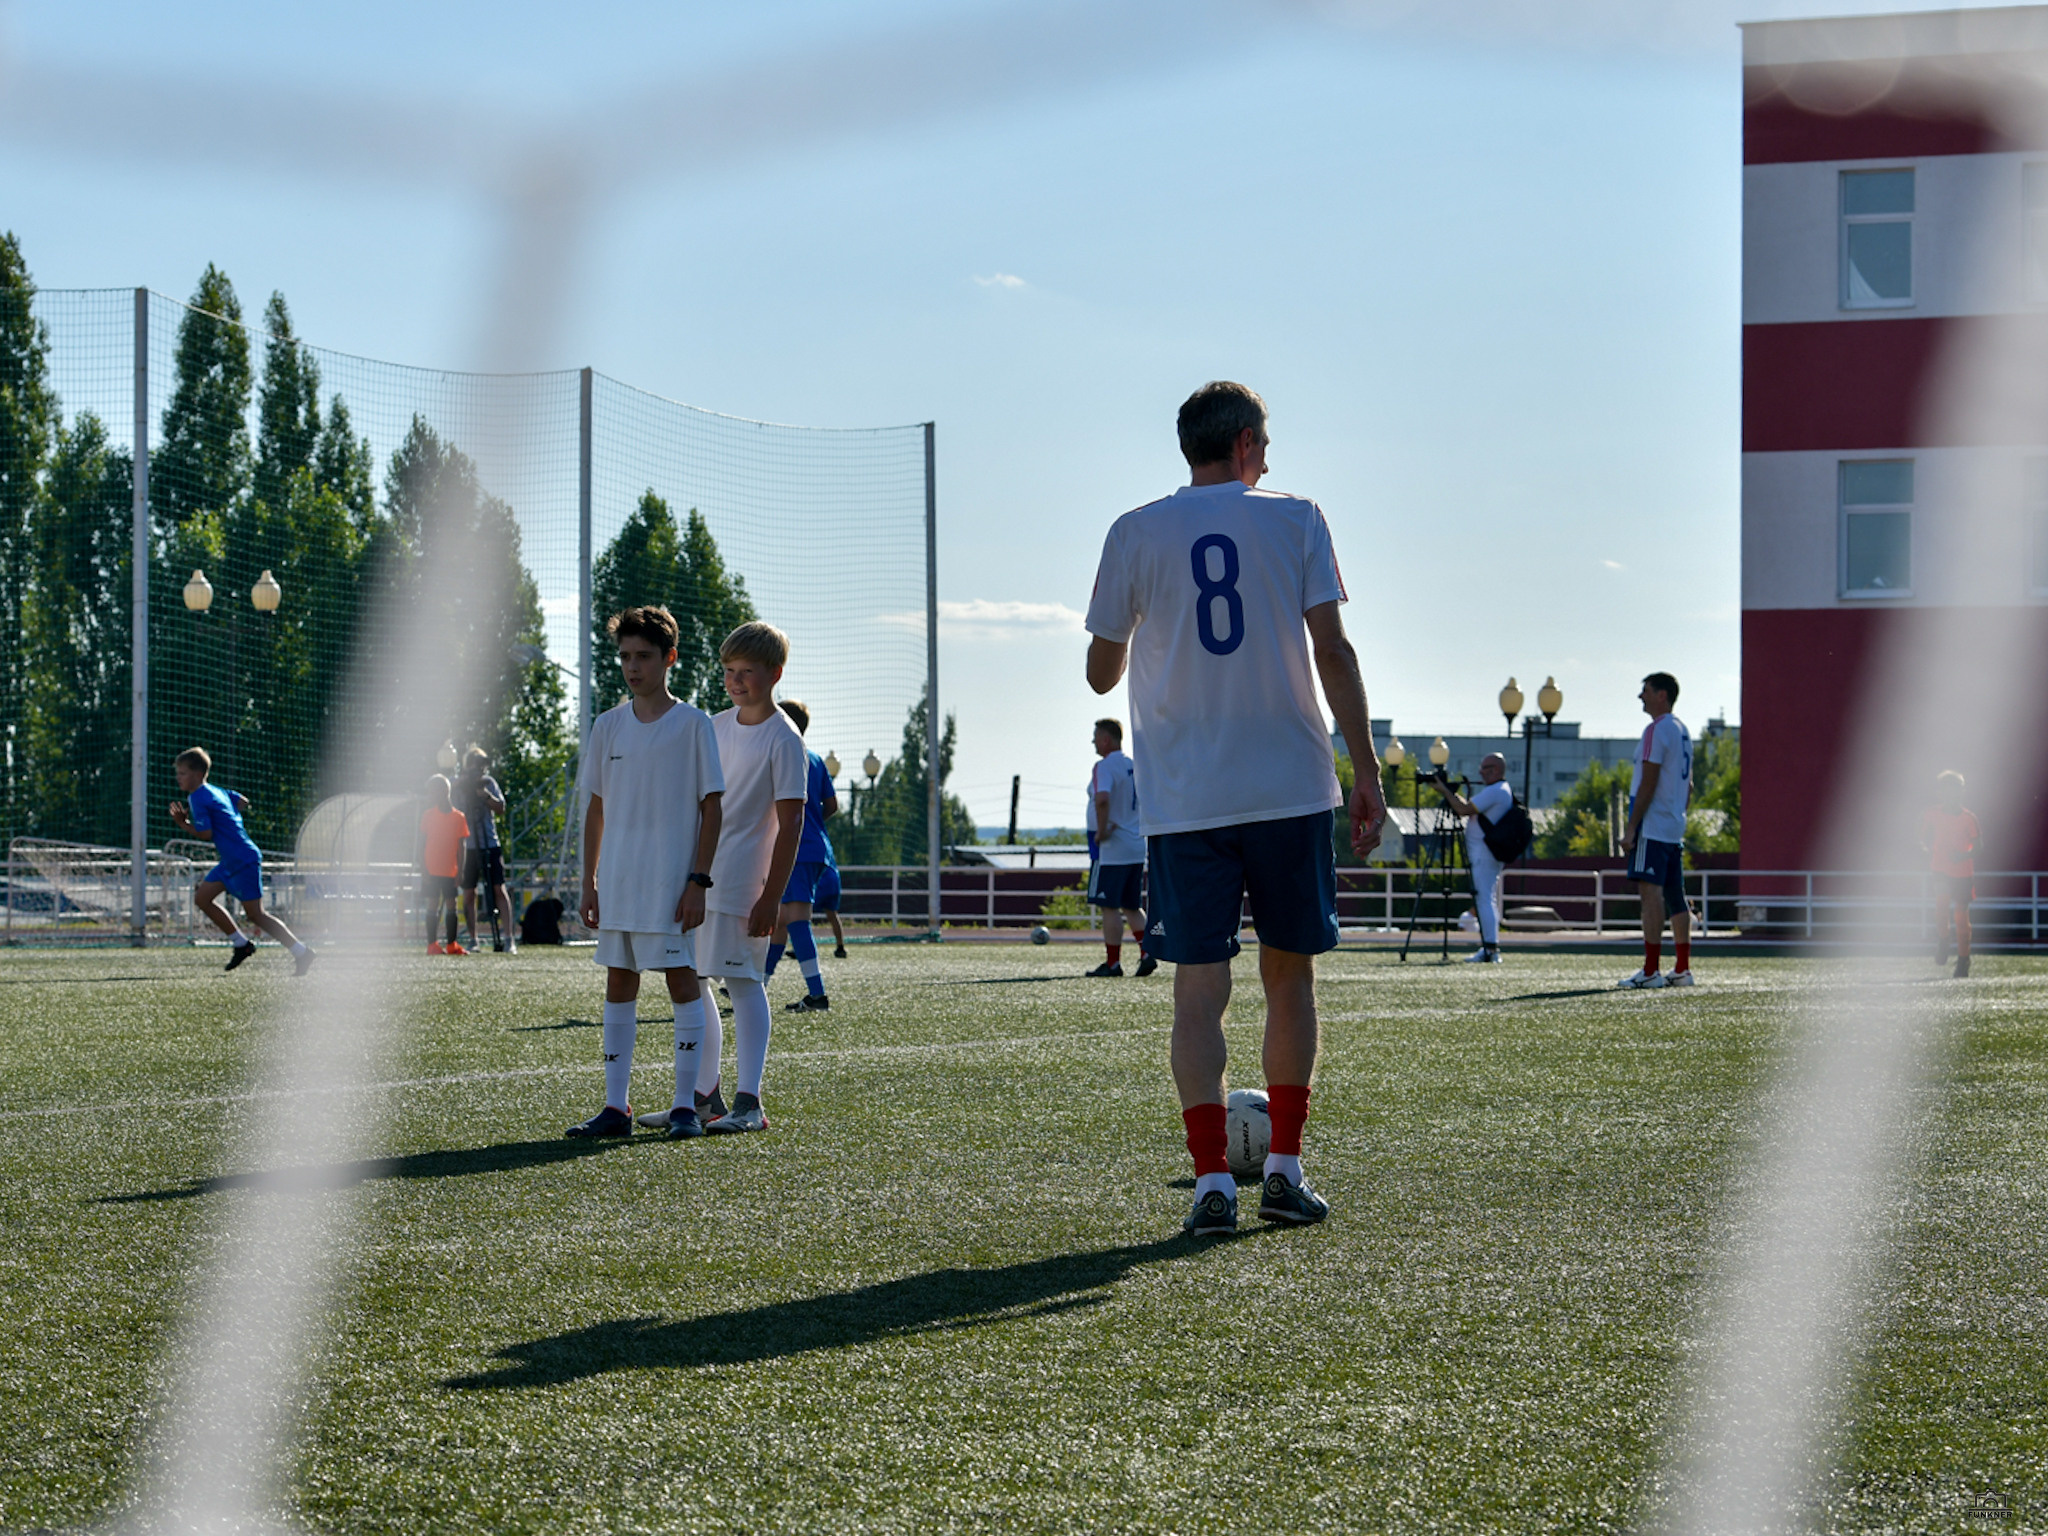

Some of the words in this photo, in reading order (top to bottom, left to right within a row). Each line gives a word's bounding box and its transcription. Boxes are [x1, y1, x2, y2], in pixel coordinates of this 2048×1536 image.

[1191, 533, 1245, 656] 8
[1682, 736, 1690, 780] 5
[1243, 1120, 1251, 1162] DEMIX
